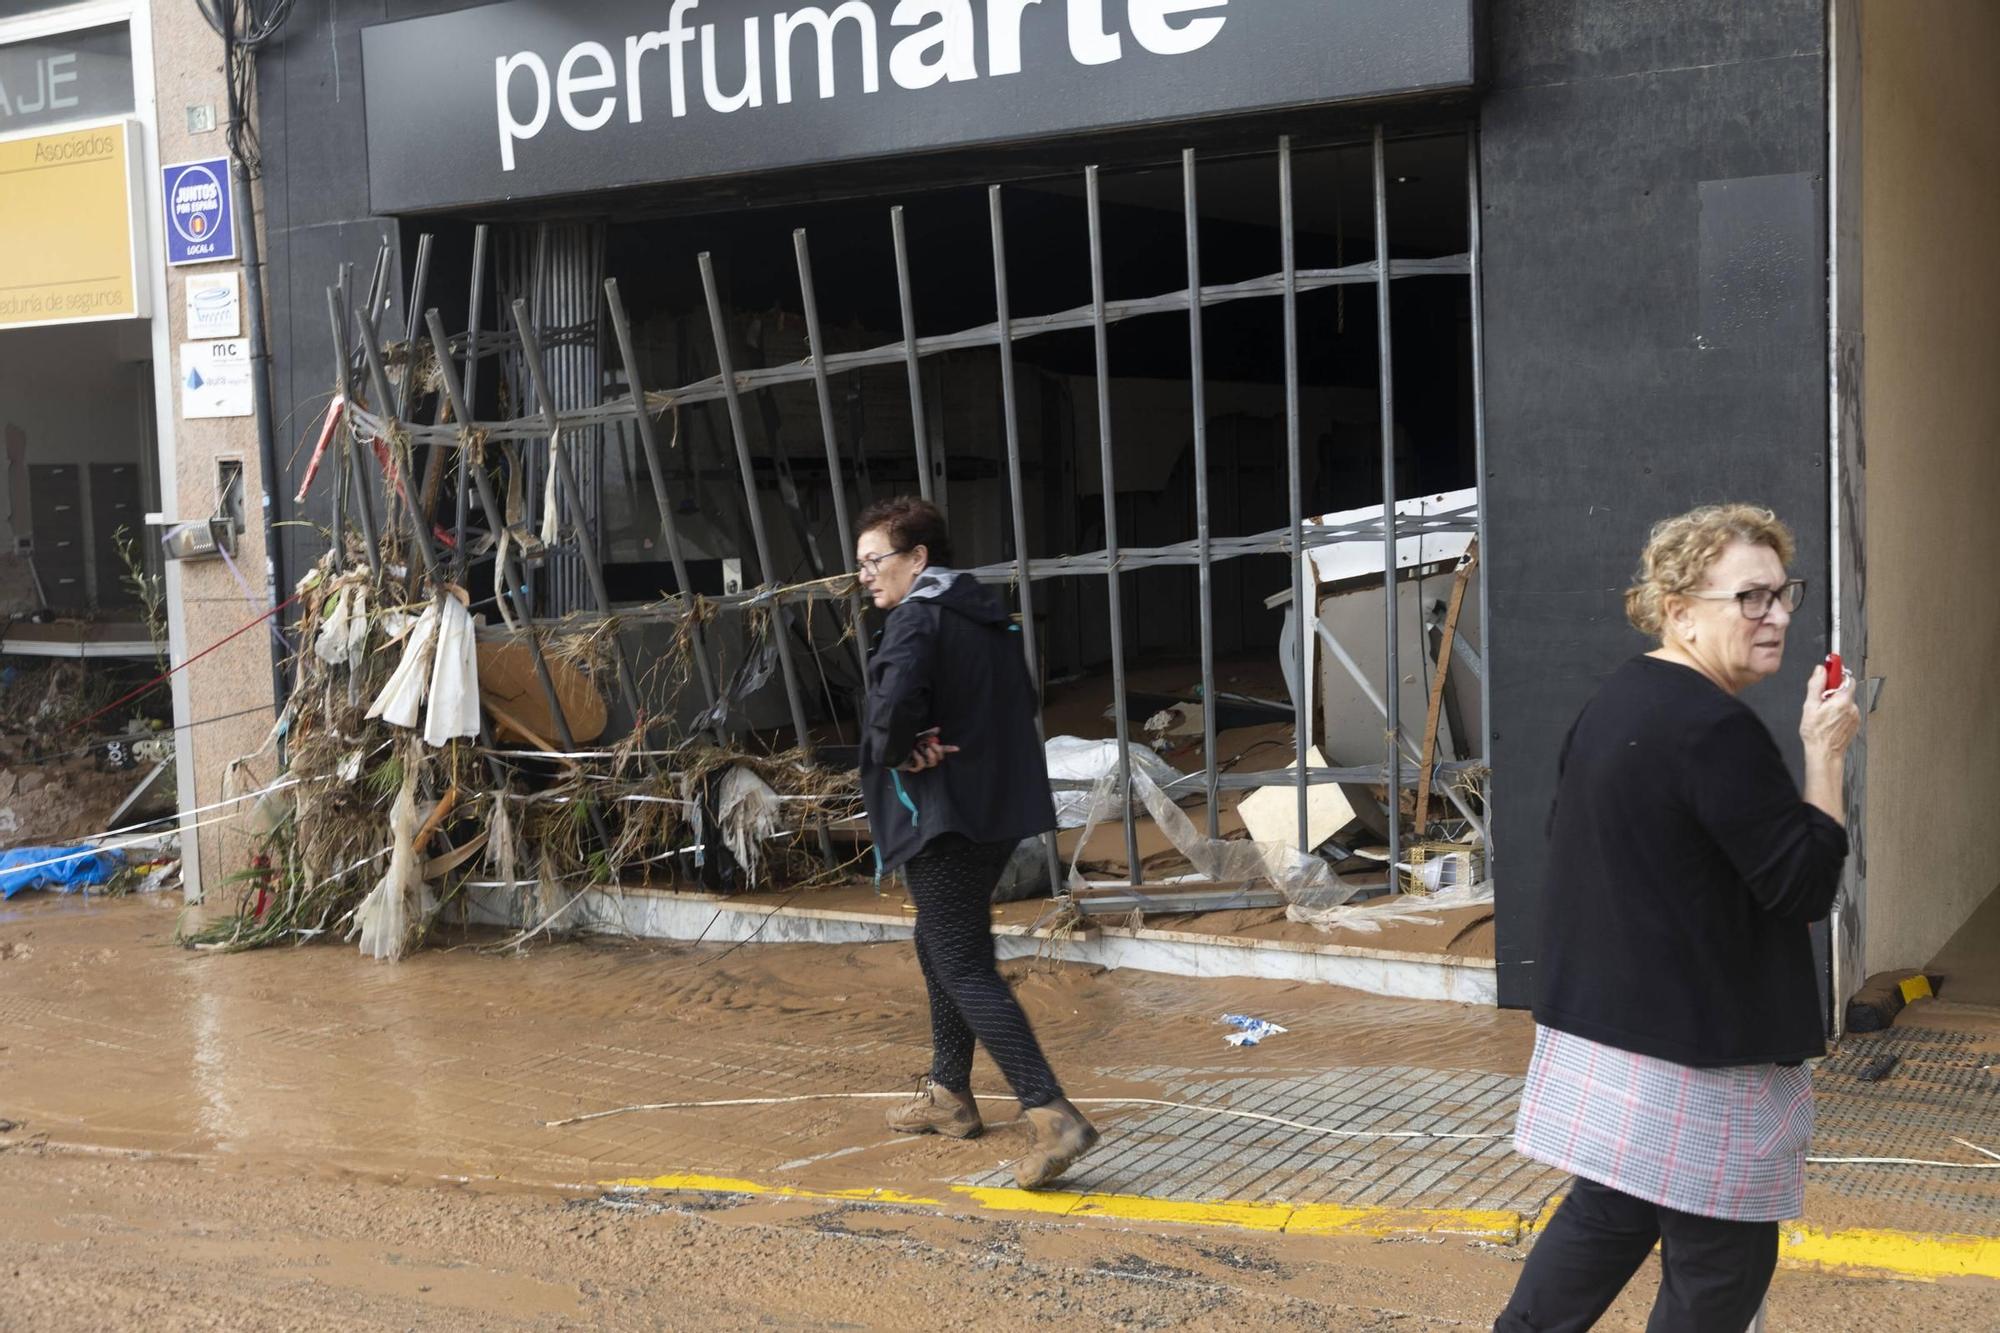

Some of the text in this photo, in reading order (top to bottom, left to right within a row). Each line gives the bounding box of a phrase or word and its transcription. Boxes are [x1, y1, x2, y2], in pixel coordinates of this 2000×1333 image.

[35, 133, 114, 162] Asociados
[176, 183, 218, 203] JUNTOS
[187, 244, 208, 255] LOCAL
[46, 292, 63, 312] de
[66, 289, 123, 313] seguros
[212, 343, 238, 357] mc
